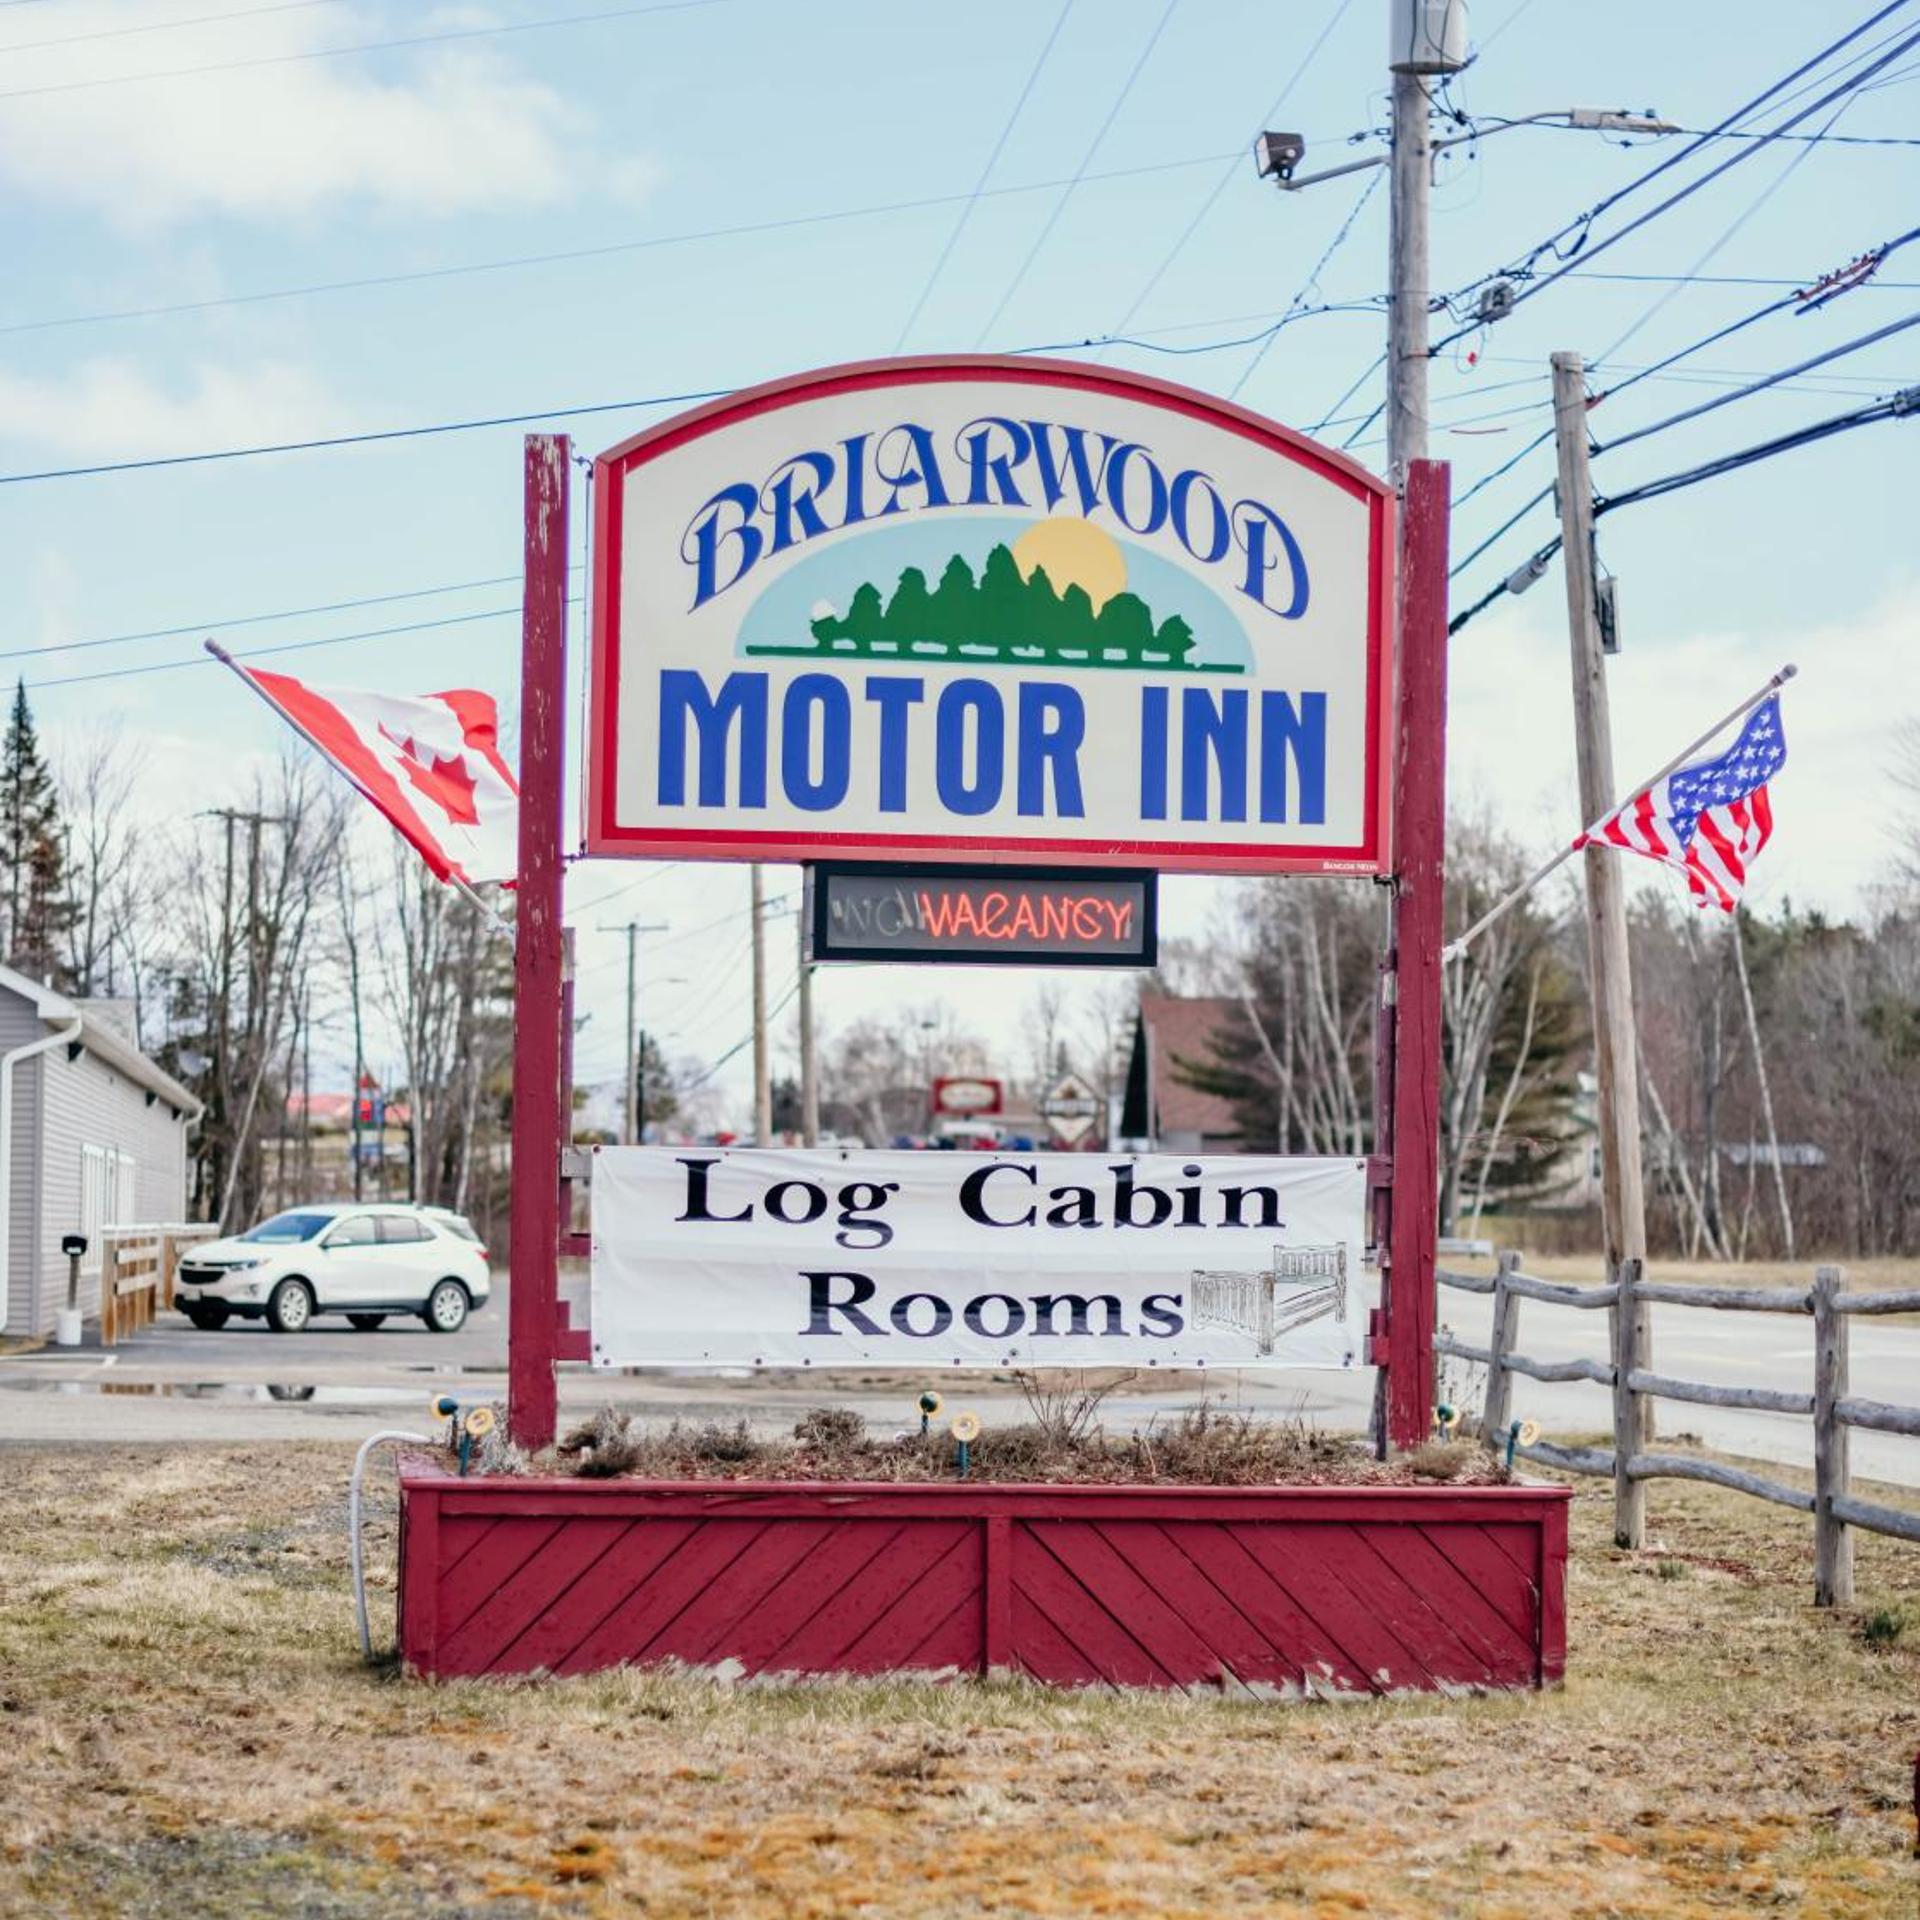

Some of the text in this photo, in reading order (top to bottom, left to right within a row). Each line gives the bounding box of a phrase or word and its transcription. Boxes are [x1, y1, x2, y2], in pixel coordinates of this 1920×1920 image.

[680, 416, 1311, 620] BRIARWOOD
[657, 668, 1328, 825] MOTOR INN
[918, 890, 1133, 941] VACANCY
[674, 1157, 1286, 1250] Log Cabin
[798, 1271, 1184, 1339] Rooms
